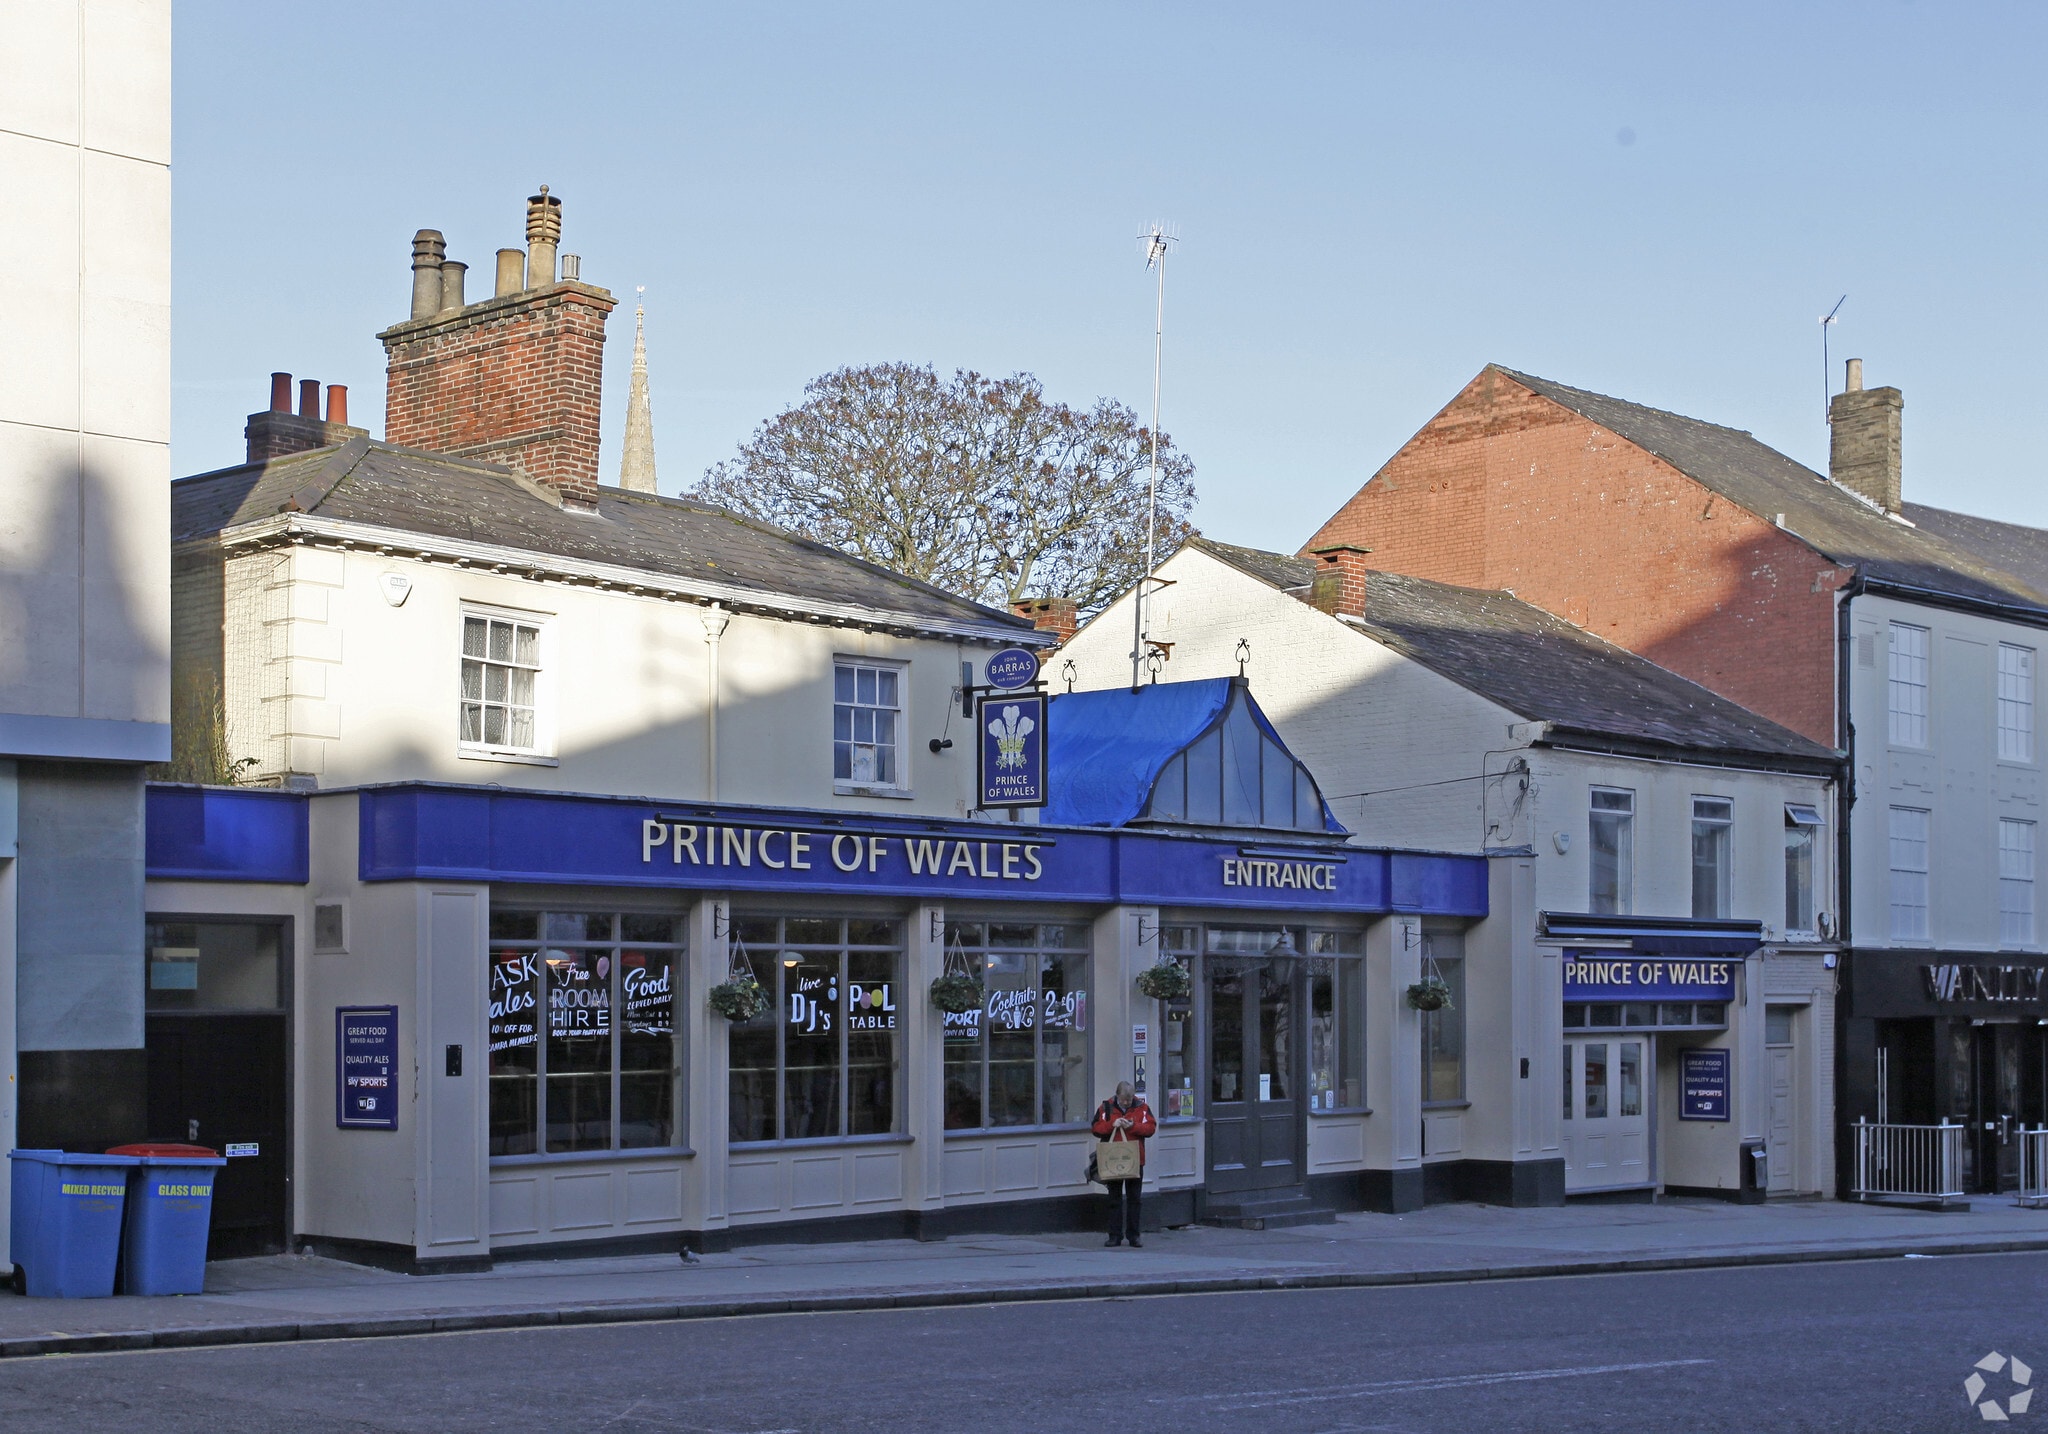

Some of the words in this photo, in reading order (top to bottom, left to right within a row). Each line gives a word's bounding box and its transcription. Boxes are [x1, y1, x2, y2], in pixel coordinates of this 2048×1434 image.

[991, 661, 1031, 674] BARRAS
[995, 774, 1028, 786] PRINCE
[988, 787, 1001, 798] OF
[1003, 786, 1035, 797] WALES
[642, 819, 812, 869] PRINCE
[831, 834, 888, 872] OF
[904, 838, 1043, 880] WALES
[1223, 859, 1337, 890] ENTRANCE
[1565, 962, 1632, 985] PRINCE
[1638, 963, 1663, 985] OF
[1668, 963, 1729, 985] WALES
[624, 965, 670, 1000] Good
[800, 977, 822, 992] live
[1927, 964, 2045, 1001] VANITY
[552, 988, 609, 1009] ROOM
[627, 998, 652, 1010] SERVED
[653, 994, 672, 1005] DAILY
[988, 986, 1036, 1018] Cocktails
[1045, 990, 1056, 1016] 2
[552, 1010, 609, 1027] HIRE
[790, 993, 831, 1032] DJ's
[504, 1025, 518, 1034] OFF
[519, 1025, 533, 1033] FOR
[850, 1016, 895, 1029] TABLE
[347, 1027, 367, 1036] GREAT
[369, 1027, 387, 1036] FOOD
[509, 1034, 538, 1048] MEMBERS
[346, 1056, 373, 1064] QUALITY
[374, 1055, 389, 1064] ALES
[348, 1077, 359, 1087] sky
[360, 1078, 388, 1087] SPORTS
[62, 1184, 89, 1195] MIXED
[158, 1185, 189, 1196] GLASS
[190, 1185, 212, 1197] ONLY
